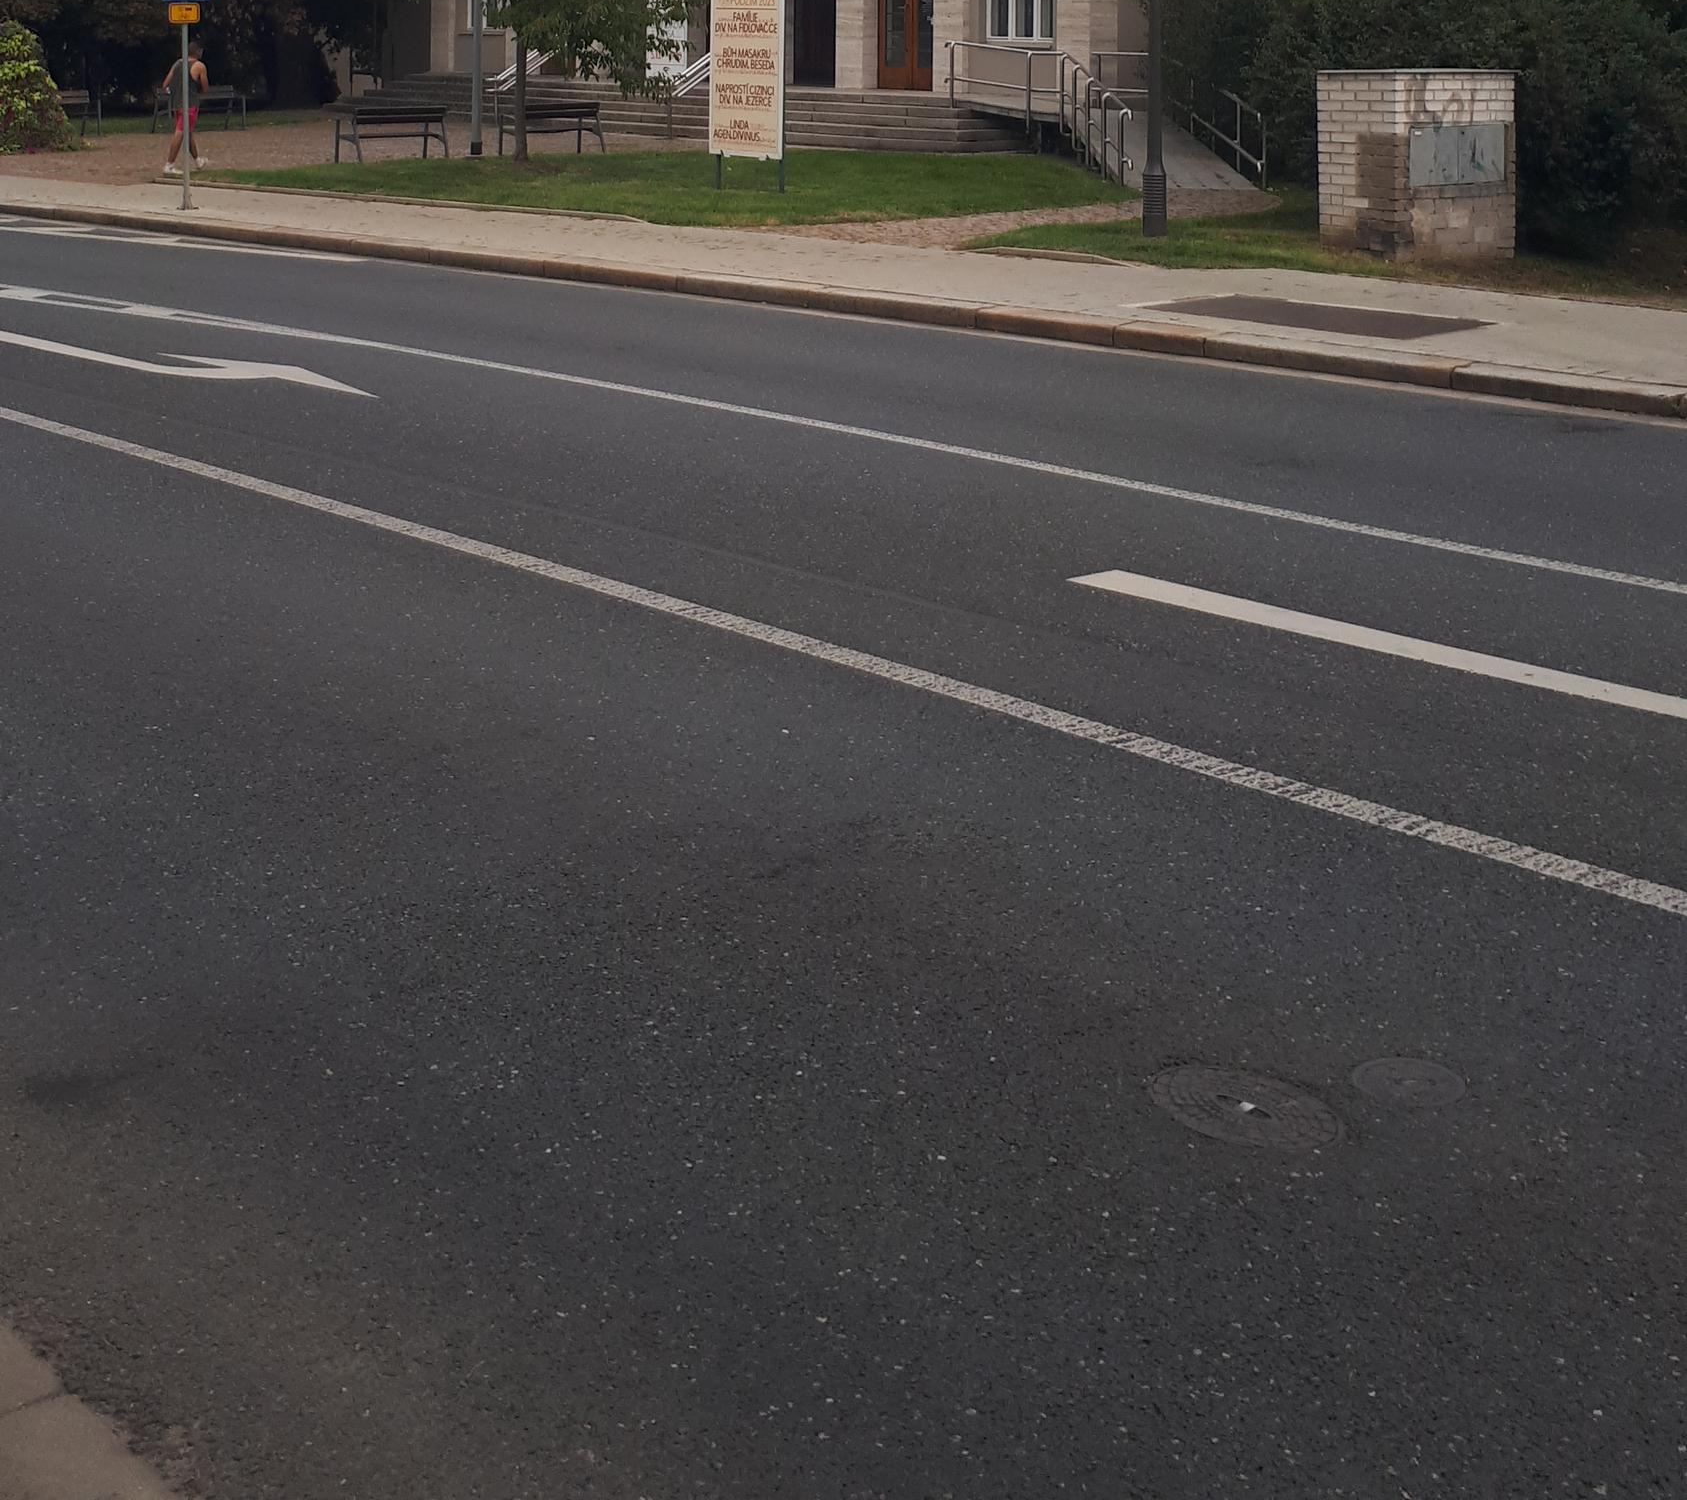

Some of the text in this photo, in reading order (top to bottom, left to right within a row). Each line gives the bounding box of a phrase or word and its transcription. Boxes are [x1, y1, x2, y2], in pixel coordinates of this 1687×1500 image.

[728, 22, 738, 33] NA
[738, 21, 778, 33] FIDLOVAČCE
[738, 47, 771, 59] MASAKRU
[750, 59, 775, 70] BESEDA
[715, 82, 775, 96] NAPROSTÍ CIZINCI
[732, 95, 743, 105] NA
[745, 95, 772, 107] JEZERCE
[729, 119, 749, 130] LINDA
